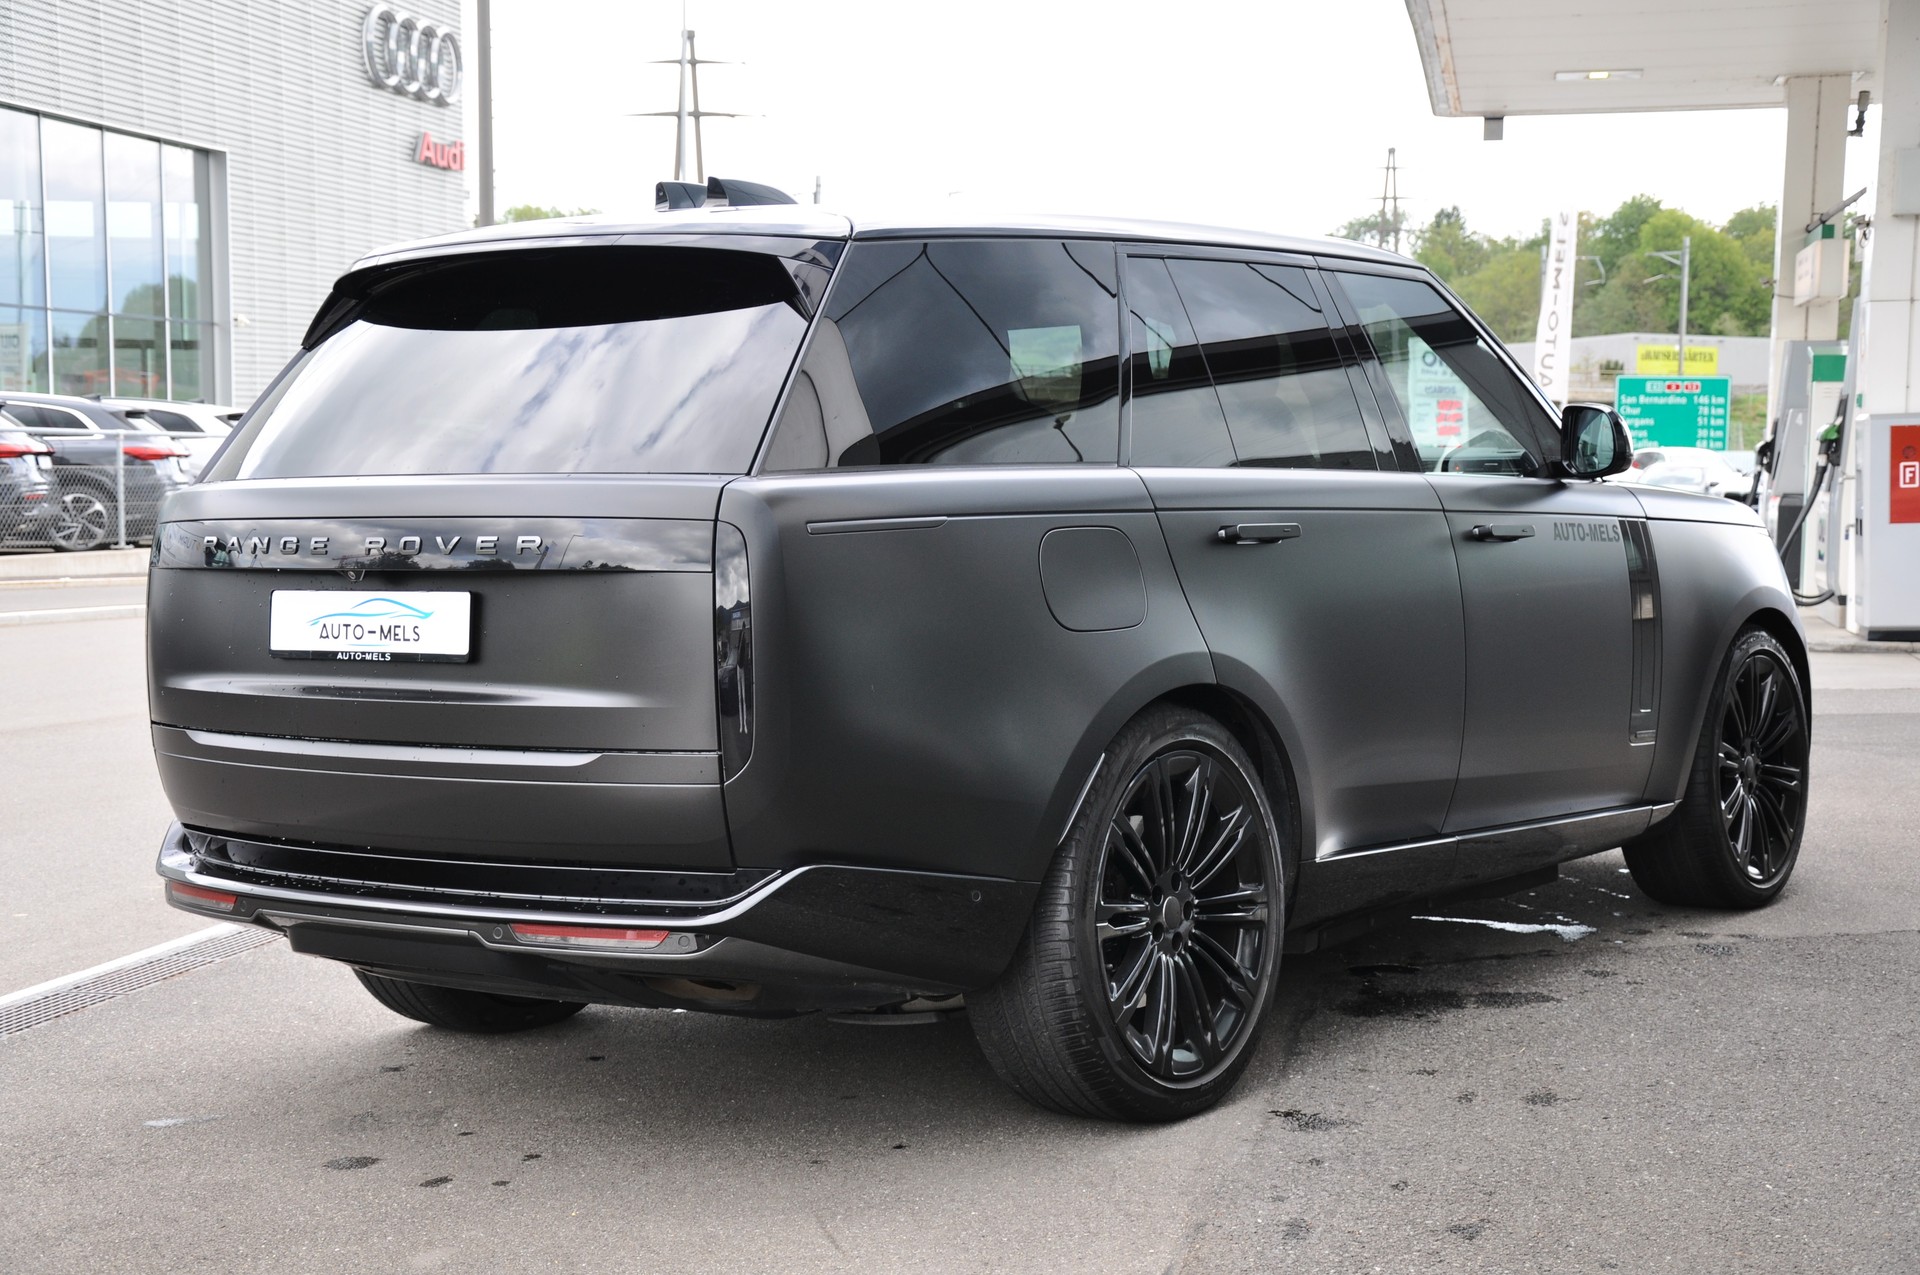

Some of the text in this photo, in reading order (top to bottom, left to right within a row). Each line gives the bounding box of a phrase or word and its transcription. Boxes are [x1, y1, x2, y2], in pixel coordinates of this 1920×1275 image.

[416, 131, 465, 171] Audi
[1620, 394, 1637, 404] San
[1639, 394, 1688, 405] Bernardino
[1711, 395, 1726, 404] km
[1619, 405, 1642, 415] Chur
[1711, 405, 1725, 415] km
[1710, 416, 1725, 426] km
[1710, 428, 1724, 438] km
[1553, 521, 1621, 543] AUTO-MELS
[203, 535, 330, 556] RANGE
[364, 535, 544, 556] ROVER
[319, 622, 421, 642] AUTO-MELS
[336, 652, 391, 661] AUTO-MELS
